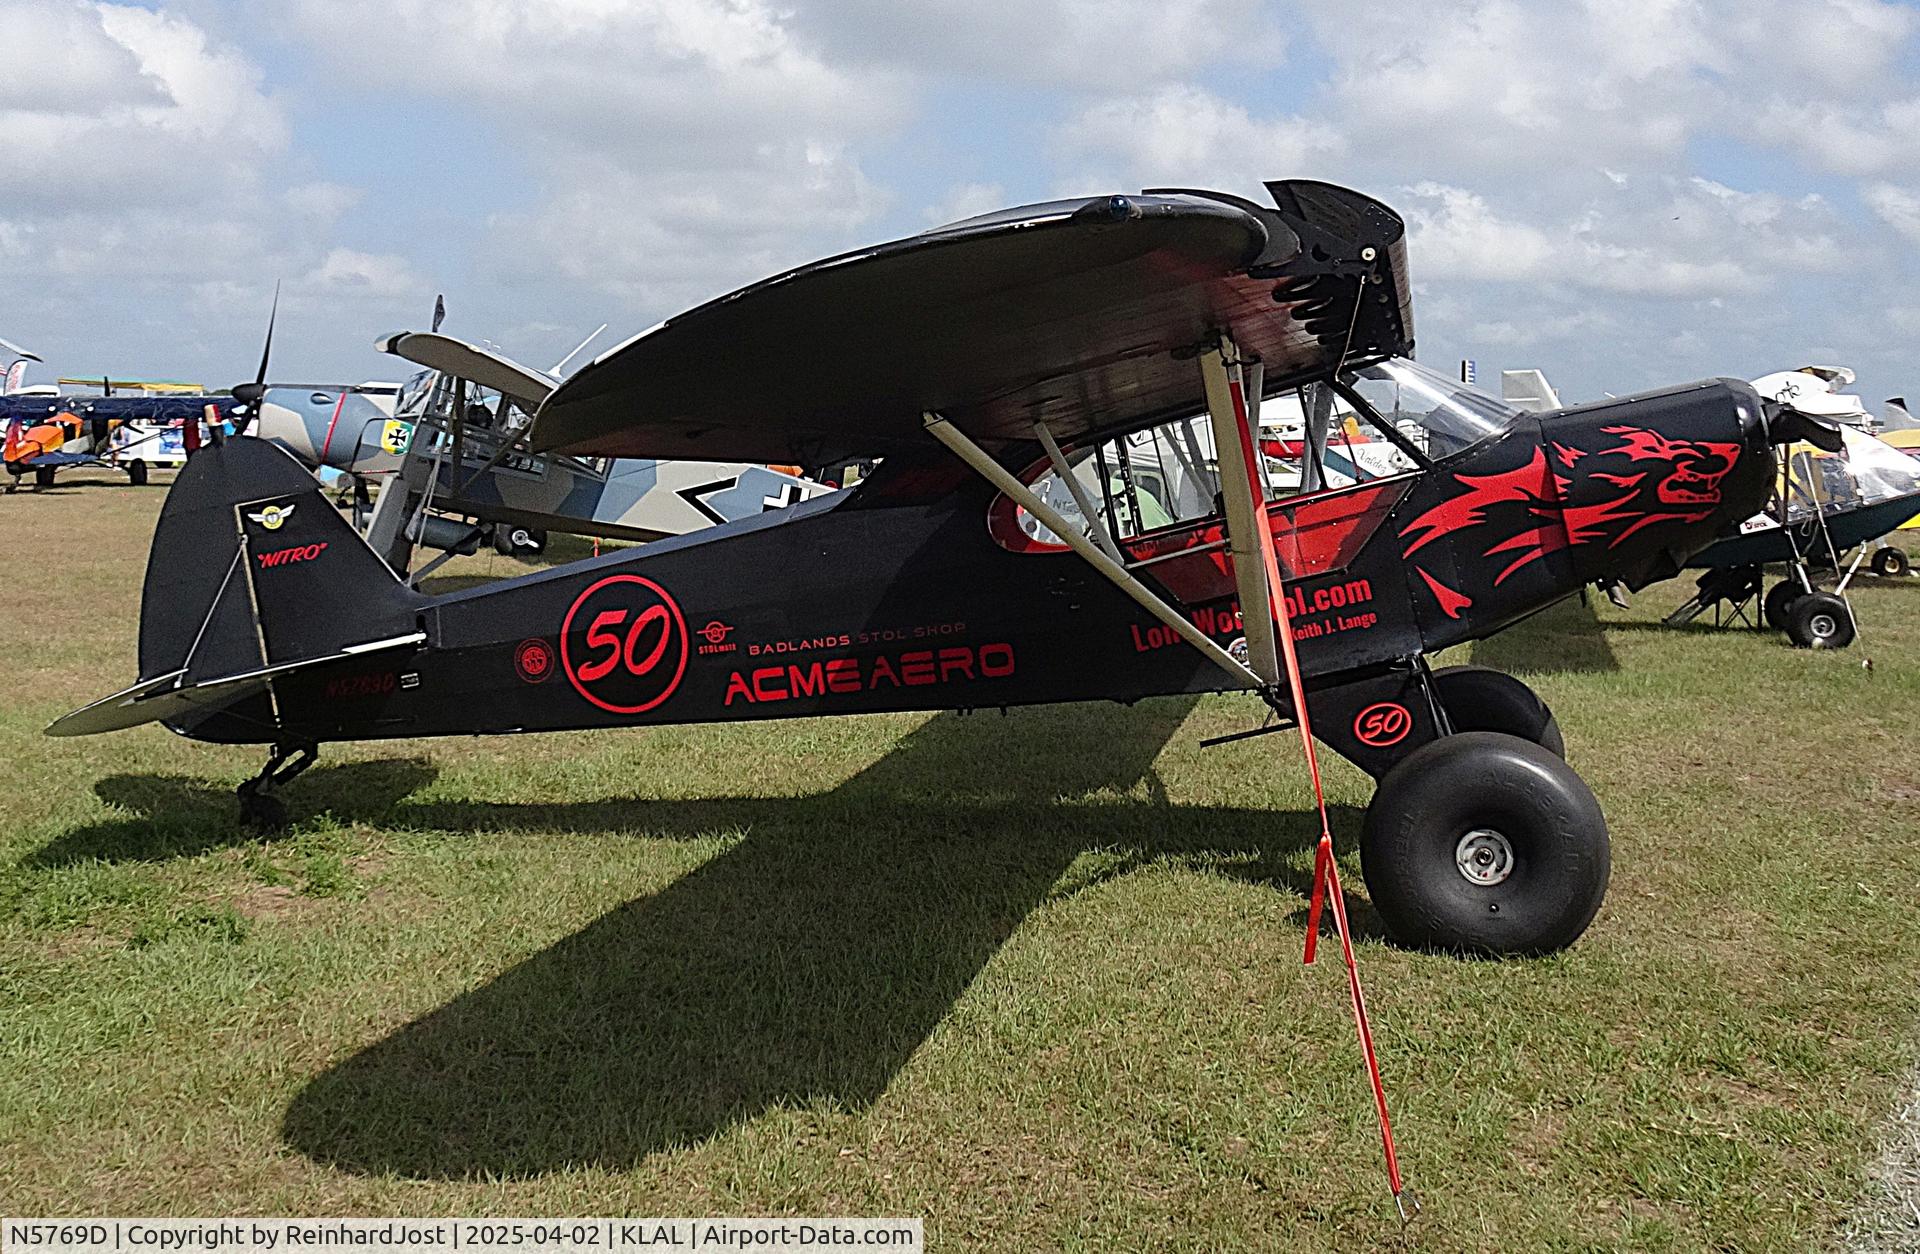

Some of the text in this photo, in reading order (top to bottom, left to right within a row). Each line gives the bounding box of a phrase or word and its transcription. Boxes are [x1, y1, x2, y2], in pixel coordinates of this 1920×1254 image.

[749, 623, 967, 656] BADLANDS STOL SHOP
[1325, 619, 1336, 634] J.
[1337, 612, 1377, 629] Lange
[577, 604, 671, 681] 50
[724, 643, 1015, 706] ACME AERO
[1364, 709, 1403, 739] 50
